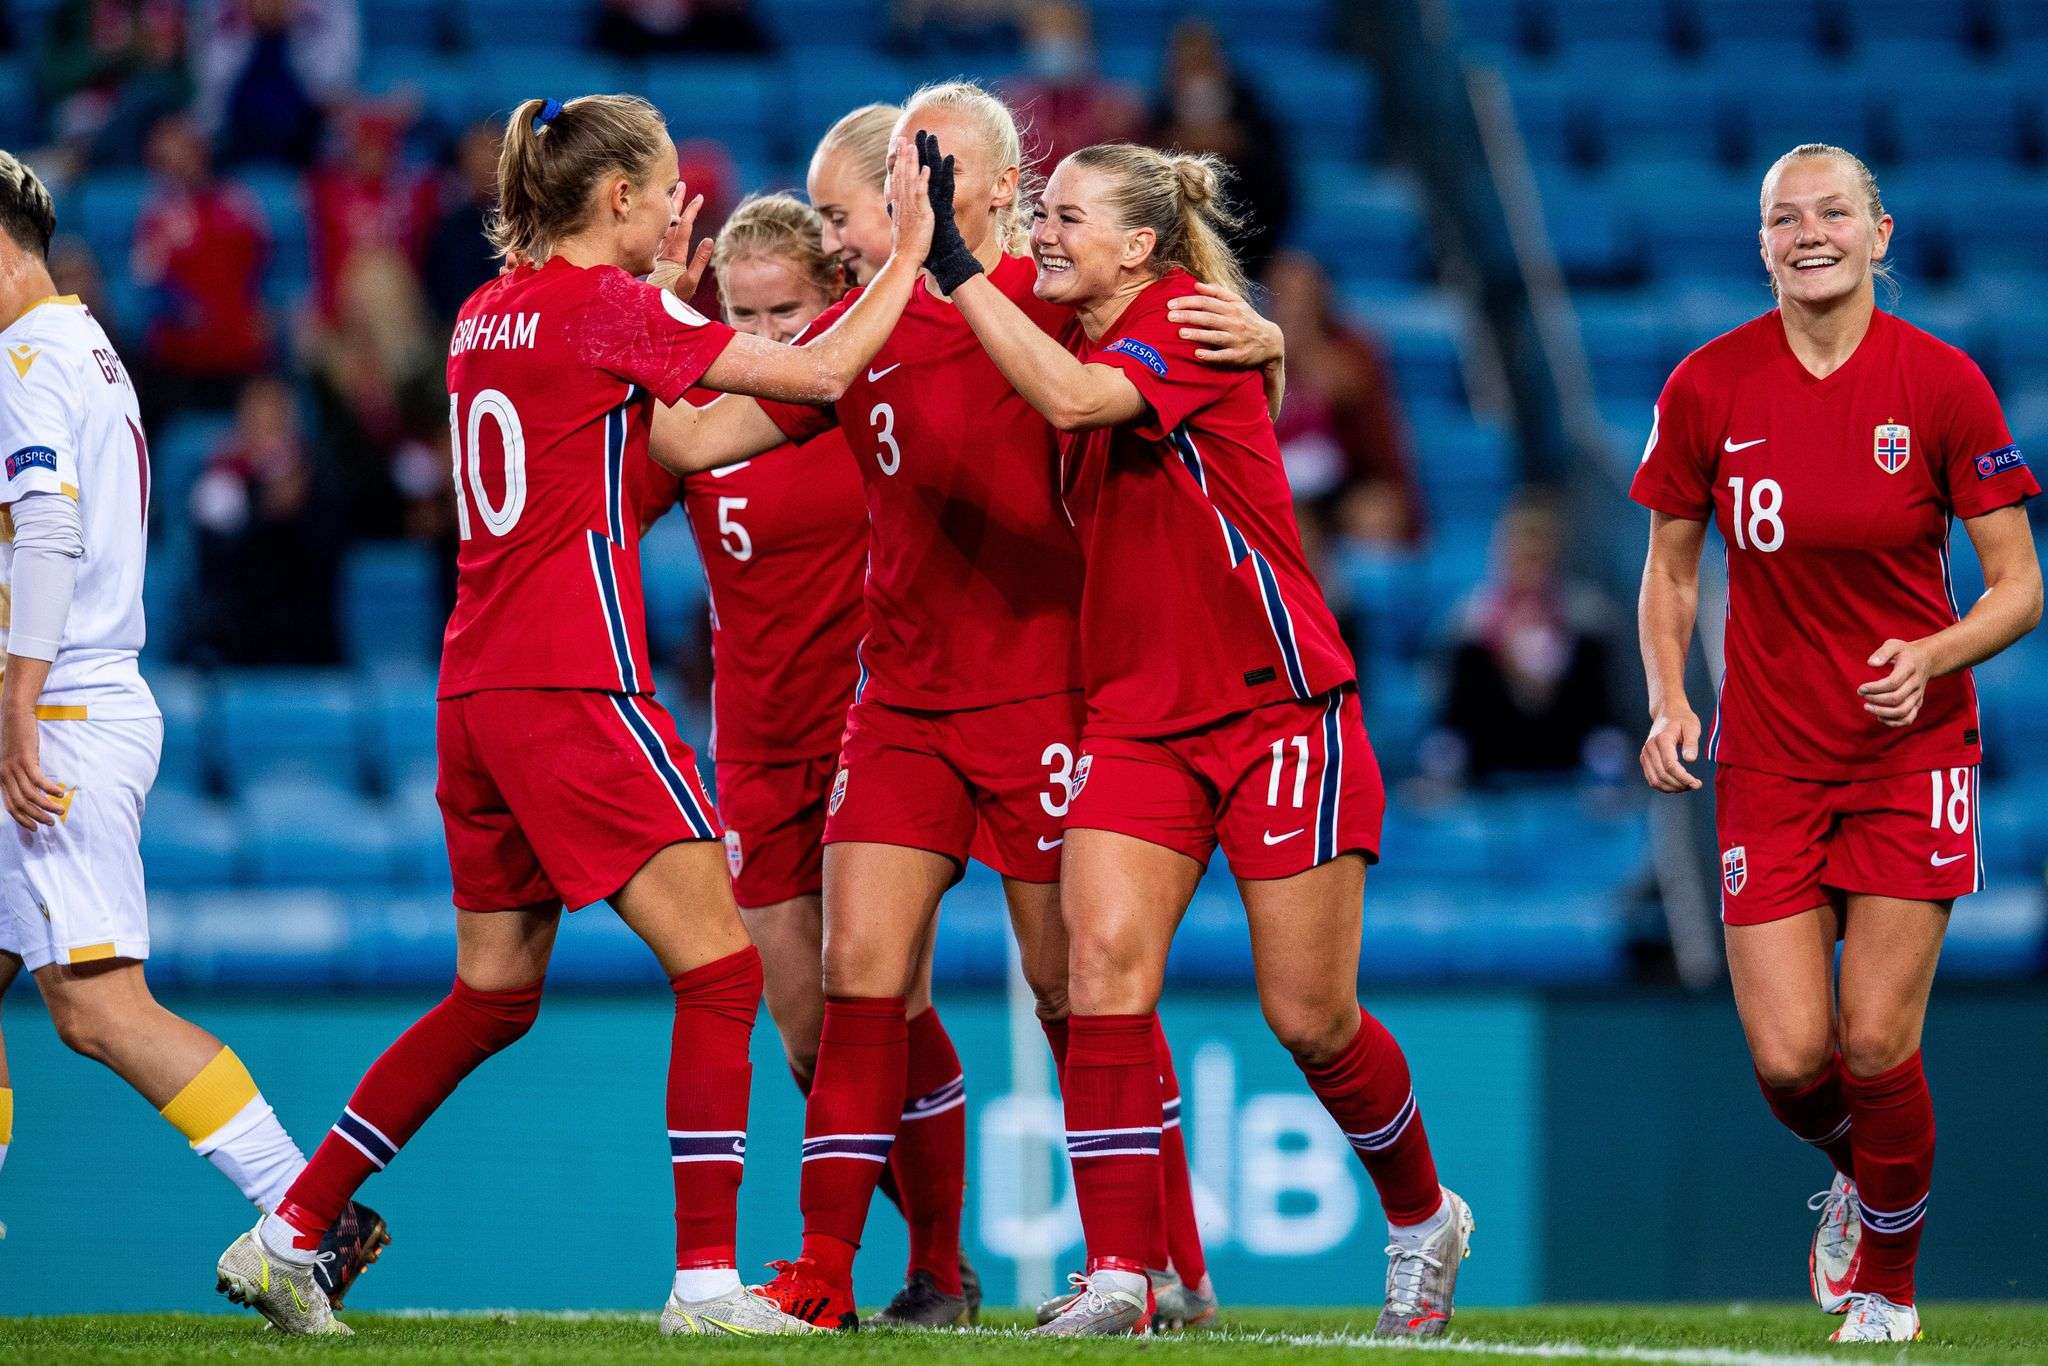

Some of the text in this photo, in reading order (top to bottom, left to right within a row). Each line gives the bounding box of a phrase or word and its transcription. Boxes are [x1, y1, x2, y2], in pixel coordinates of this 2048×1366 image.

[450, 312, 541, 357] GRAHAM
[1124, 342, 1166, 375] RESPECT
[14, 451, 57, 466] RESPECT
[449, 388, 528, 541] 10
[869, 402, 901, 476] 3
[718, 496, 752, 562] 5
[1727, 476, 1785, 552] 18
[1036, 742, 1074, 817] 3
[1267, 735, 1309, 808] 11
[1930, 767, 1969, 835] 18
